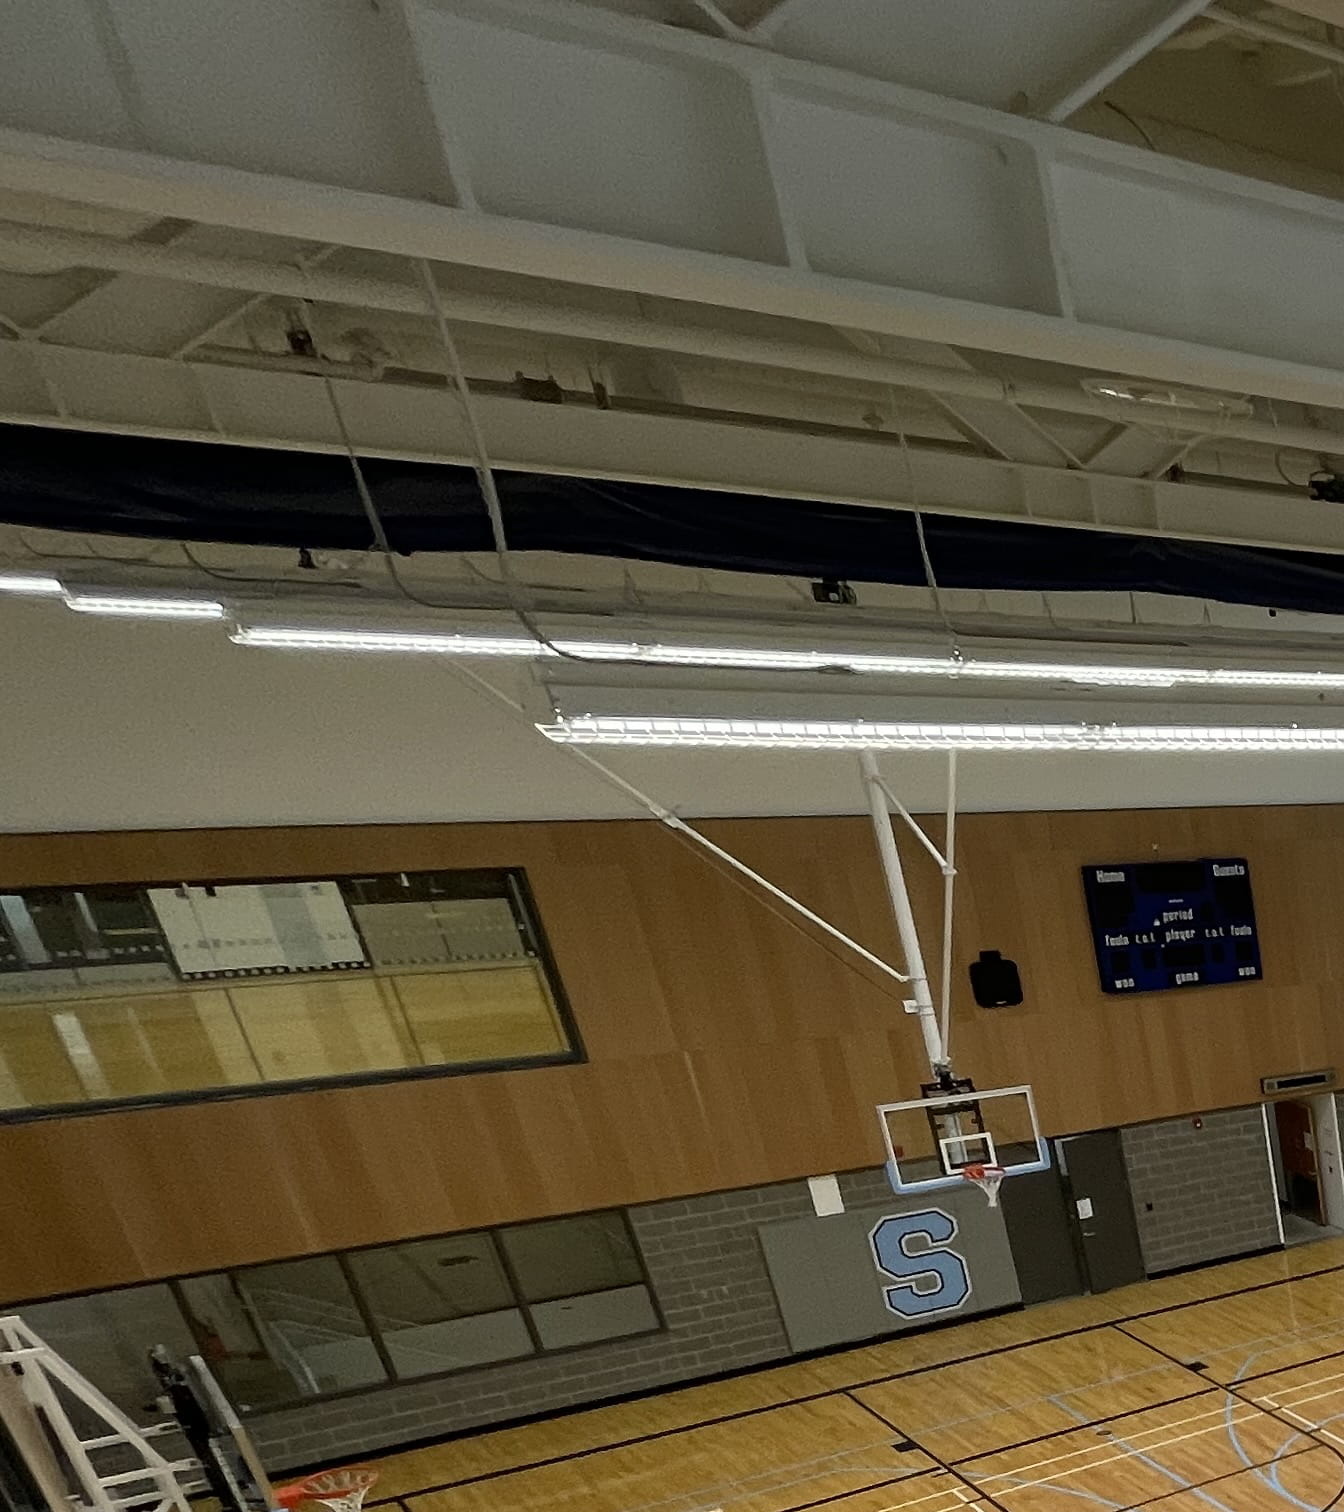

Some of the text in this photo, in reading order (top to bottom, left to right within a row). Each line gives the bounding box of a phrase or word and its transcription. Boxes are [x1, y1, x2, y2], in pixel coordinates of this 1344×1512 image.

[1163, 908, 1194, 924] period
[1165, 928, 1195, 943] player
[868, 1207, 972, 1320] S
